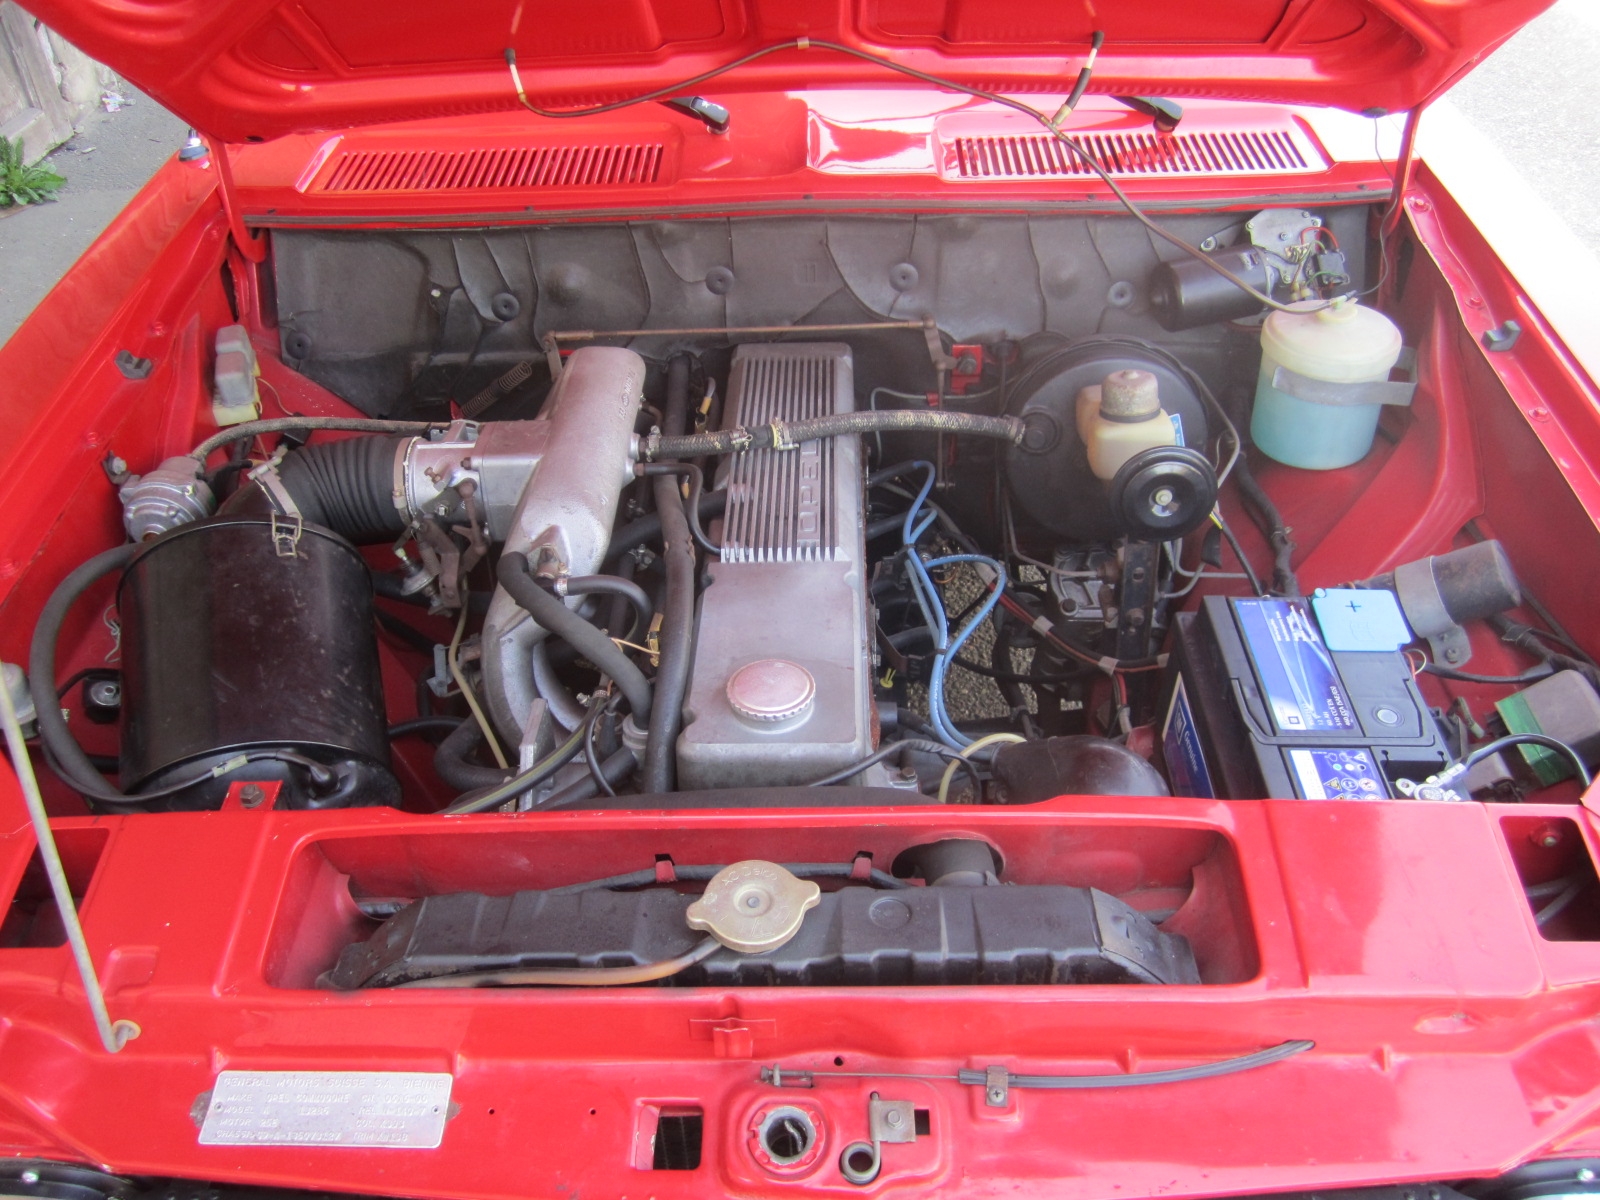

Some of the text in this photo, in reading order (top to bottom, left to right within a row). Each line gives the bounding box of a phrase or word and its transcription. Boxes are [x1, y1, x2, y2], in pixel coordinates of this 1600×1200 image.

[800, 437, 819, 533] OPEL
[1184, 730, 1199, 774] Genuine
[224, 1077, 271, 1088] GENERAL
[276, 1078, 320, 1088] MOTORS
[327, 1078, 366, 1089] SUISSE
[403, 1079, 445, 1089] BIENNE
[227, 1093, 253, 1103] MAKE
[224, 1105, 255, 1115] MODEL
[220, 1118, 252, 1128] MOTOR
